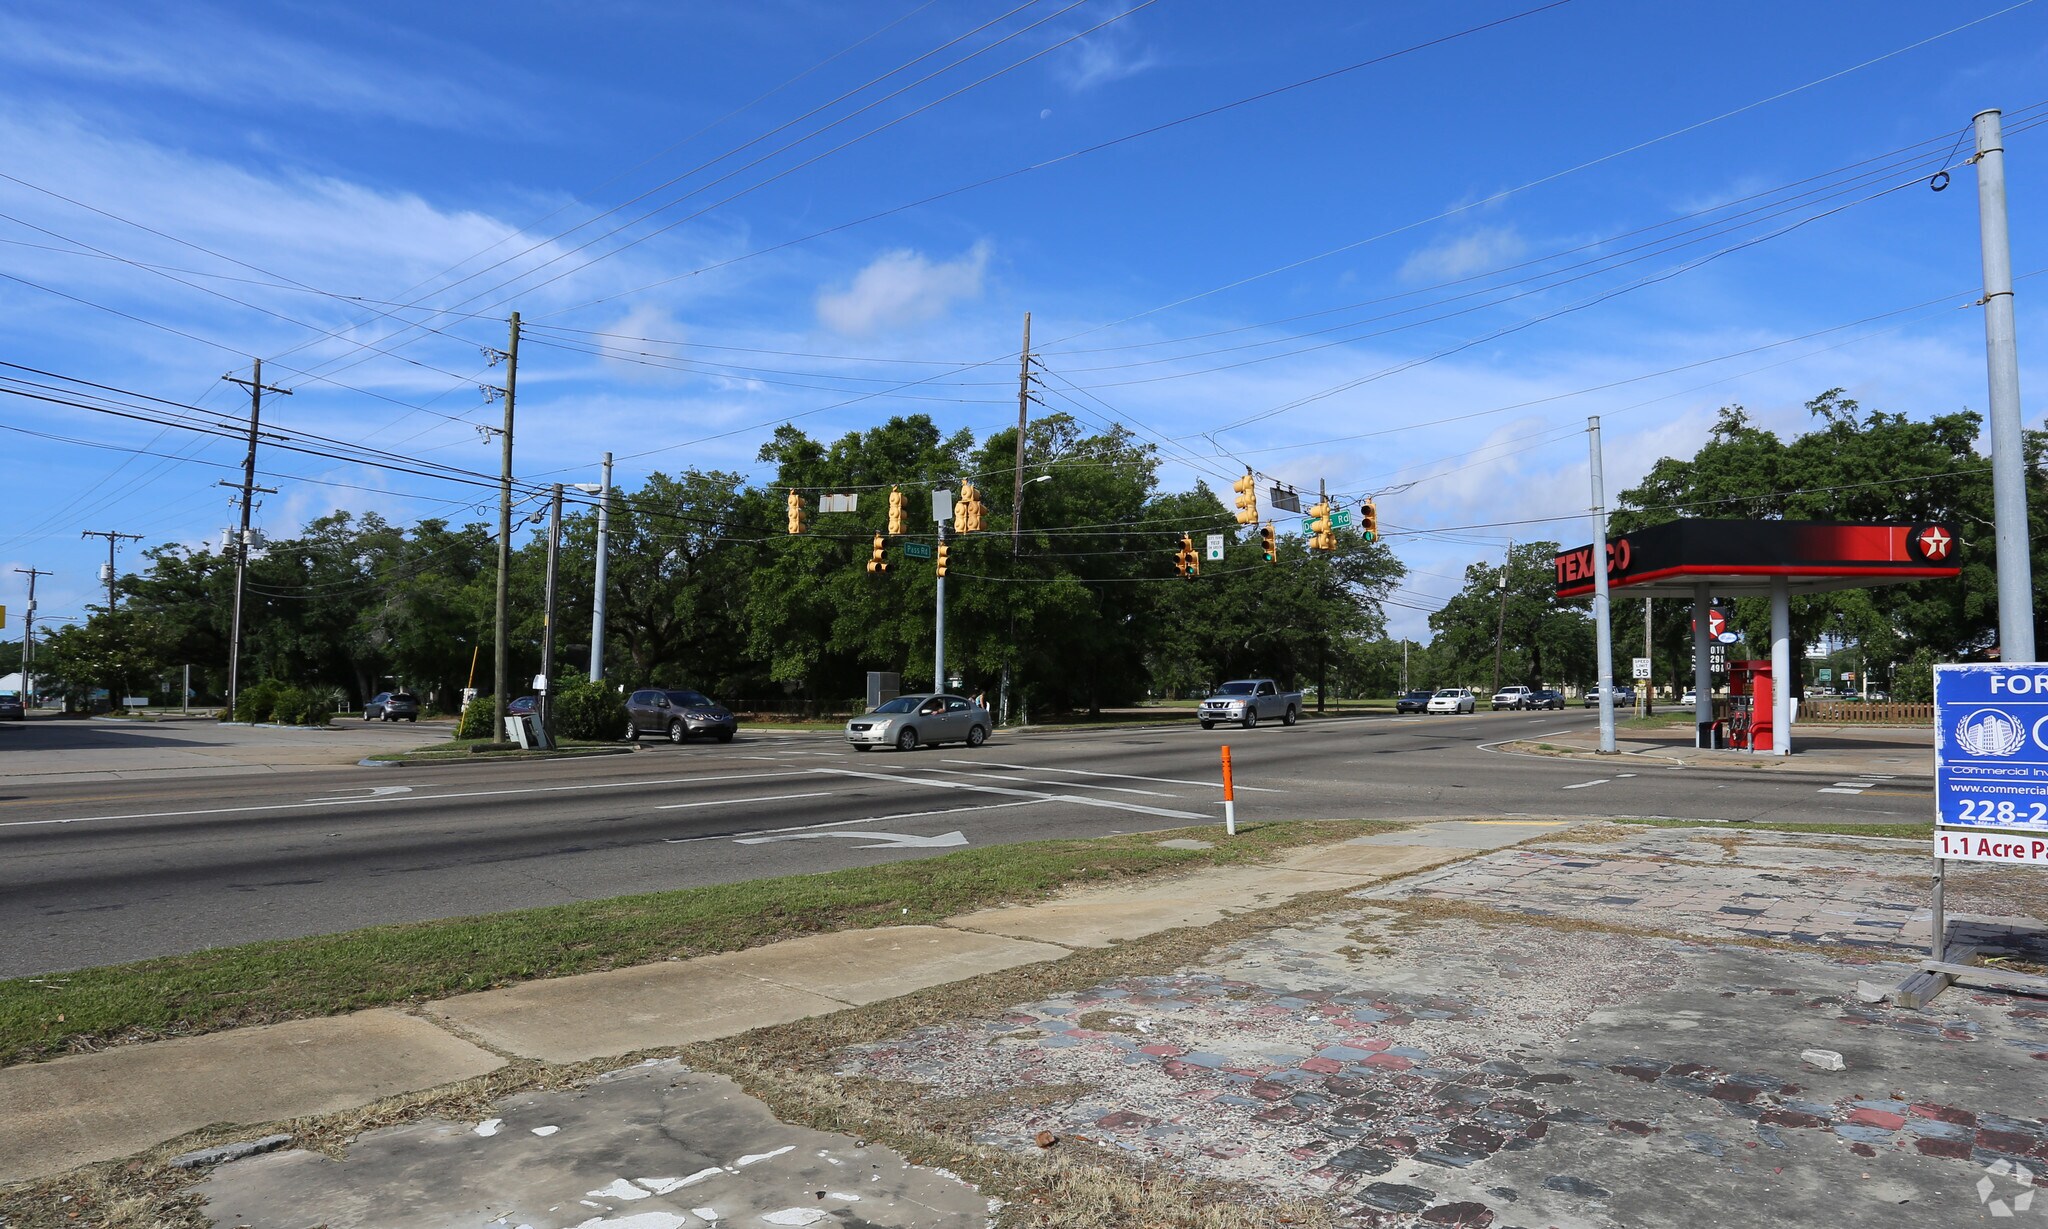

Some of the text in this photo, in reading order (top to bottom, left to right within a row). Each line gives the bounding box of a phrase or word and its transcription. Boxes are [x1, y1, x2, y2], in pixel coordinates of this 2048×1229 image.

[1337, 514, 1349, 524] Rd
[907, 545, 928, 555] Pass Rd
[1635, 668, 1649, 677] 35
[1990, 674, 2048, 694] FOR
[1952, 765, 2028, 776] Commercial
[1950, 784, 2048, 796] www.commercial
[1958, 799, 2048, 825] 228-2
[1940, 836, 2048, 859] 1.1 Acre P
